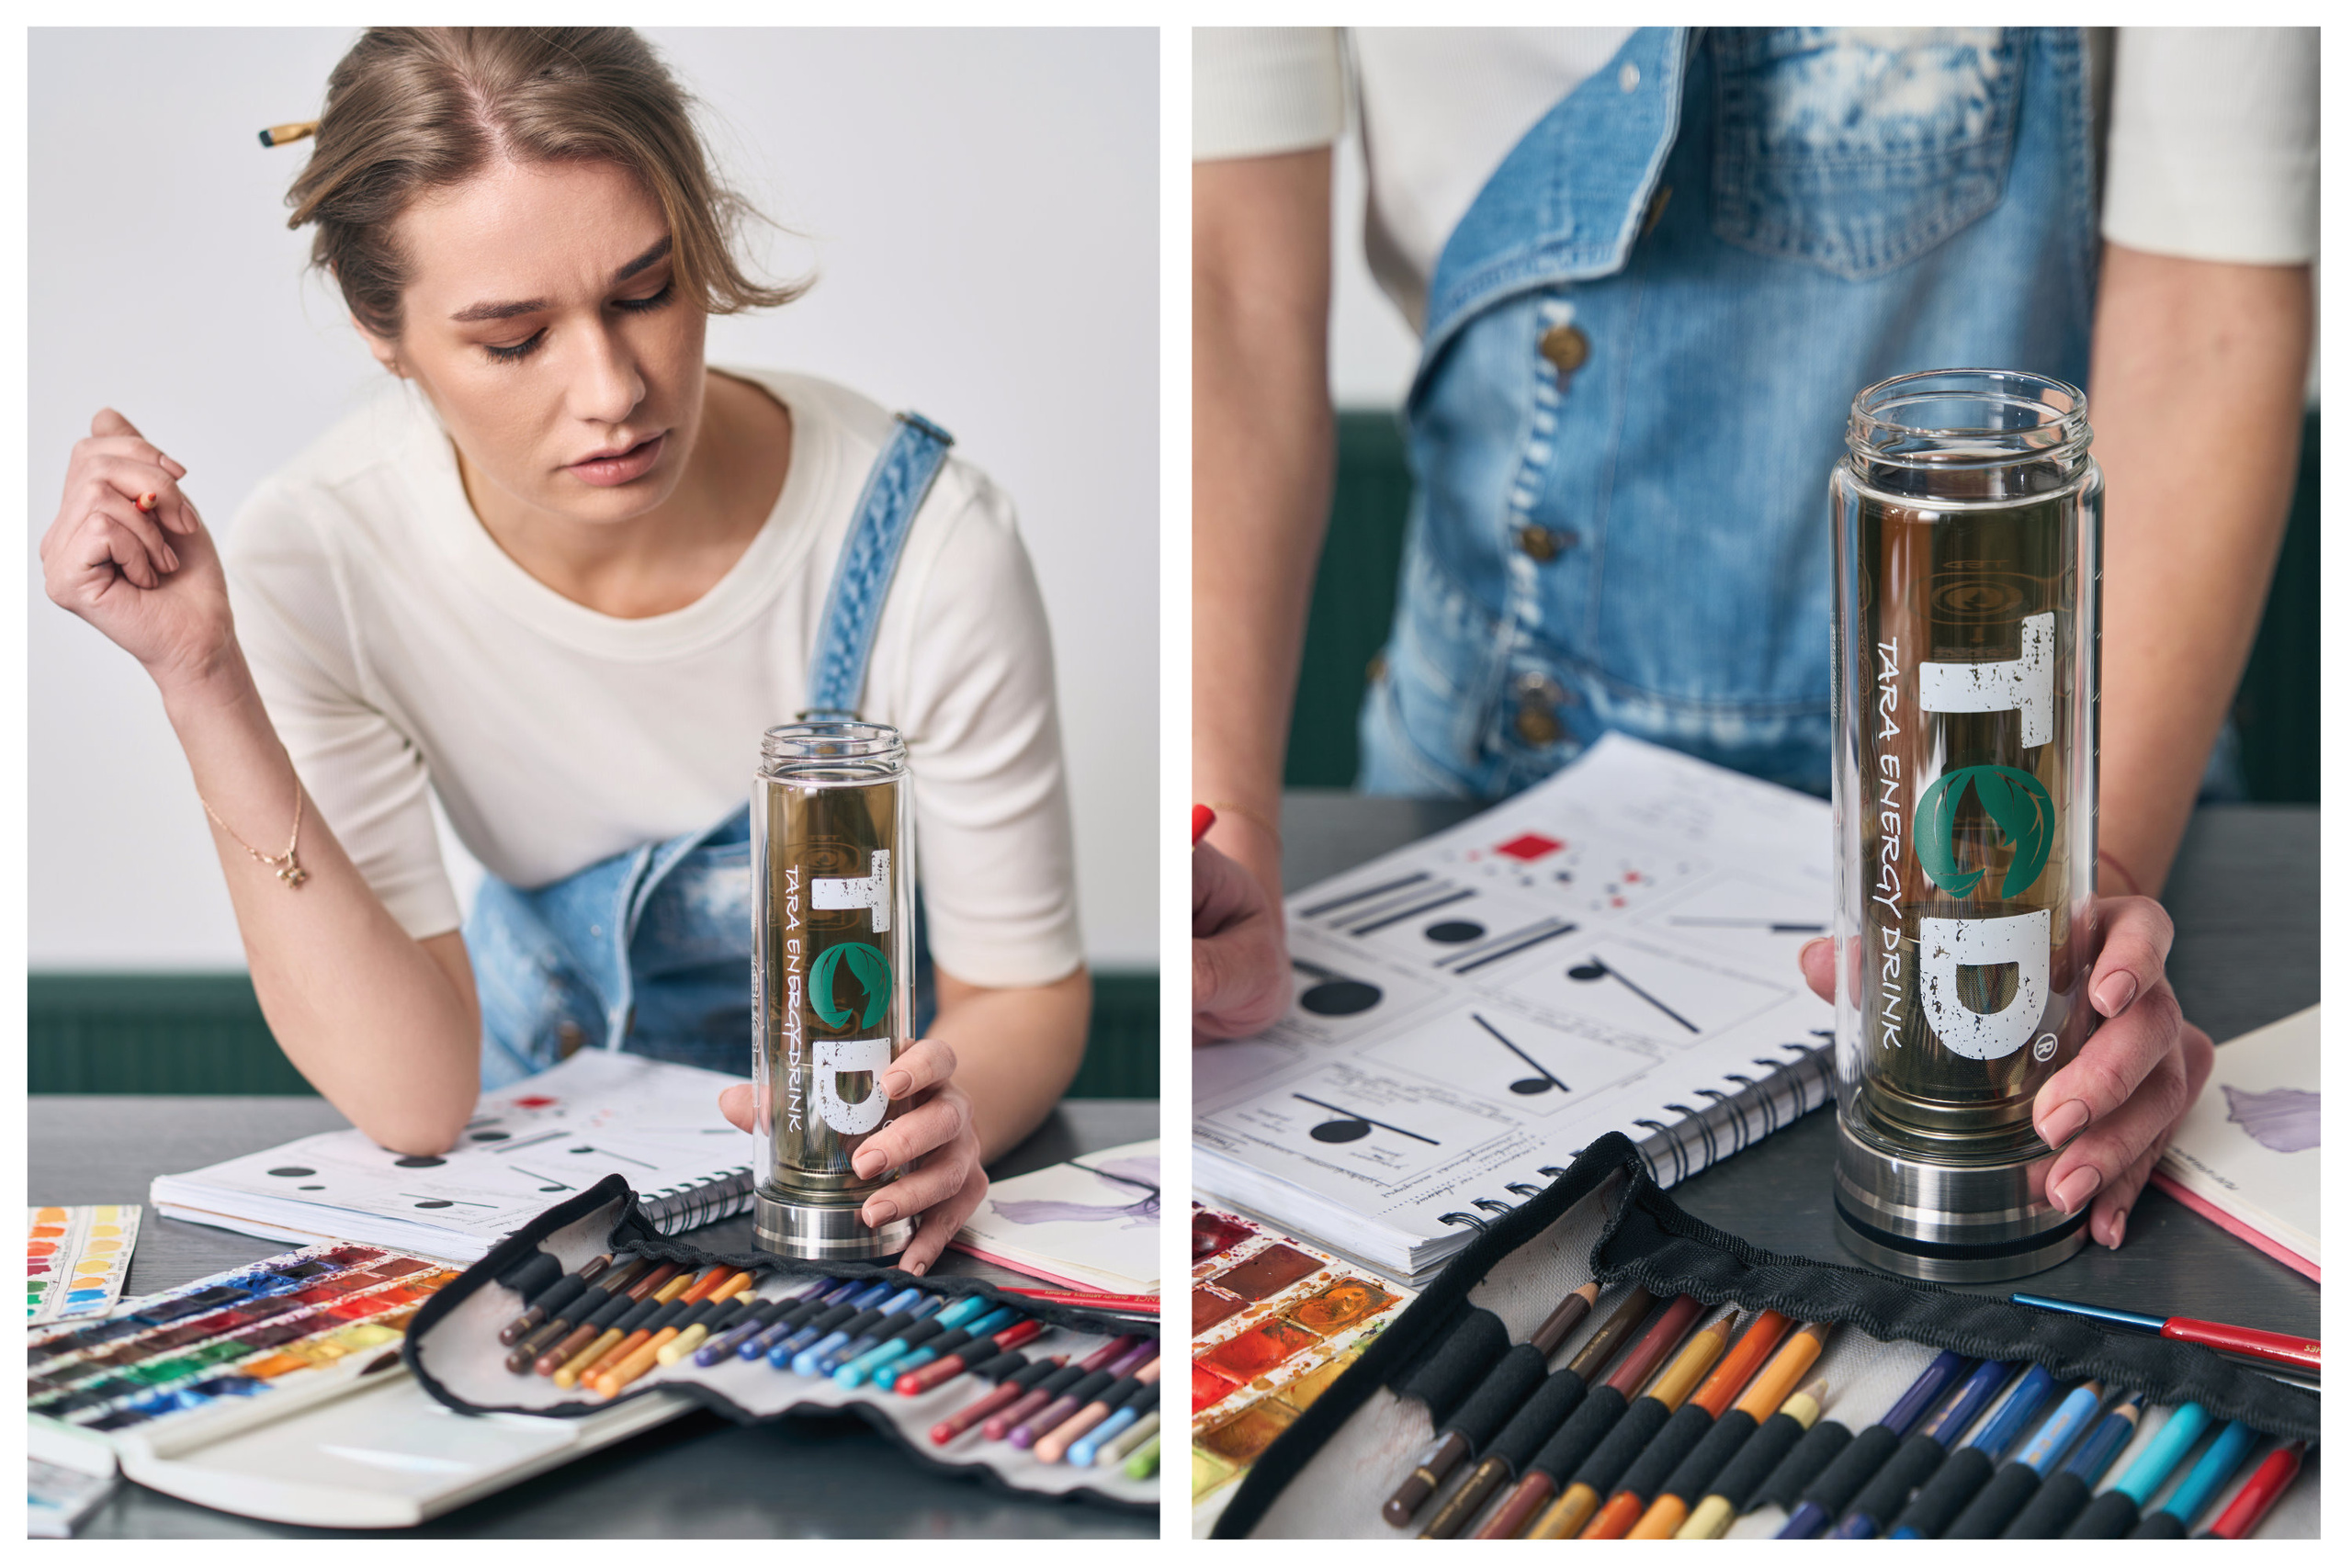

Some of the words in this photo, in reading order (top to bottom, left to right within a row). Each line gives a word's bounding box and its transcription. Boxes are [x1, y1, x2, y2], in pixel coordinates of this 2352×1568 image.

[1877, 637, 1901, 742] TARA
[1872, 754, 1902, 919] ENERGY
[786, 864, 801, 931] TARA
[782, 939, 802, 1046] ENERGY
[1881, 927, 1903, 1050] DRINK
[786, 1051, 802, 1134] DRINK
